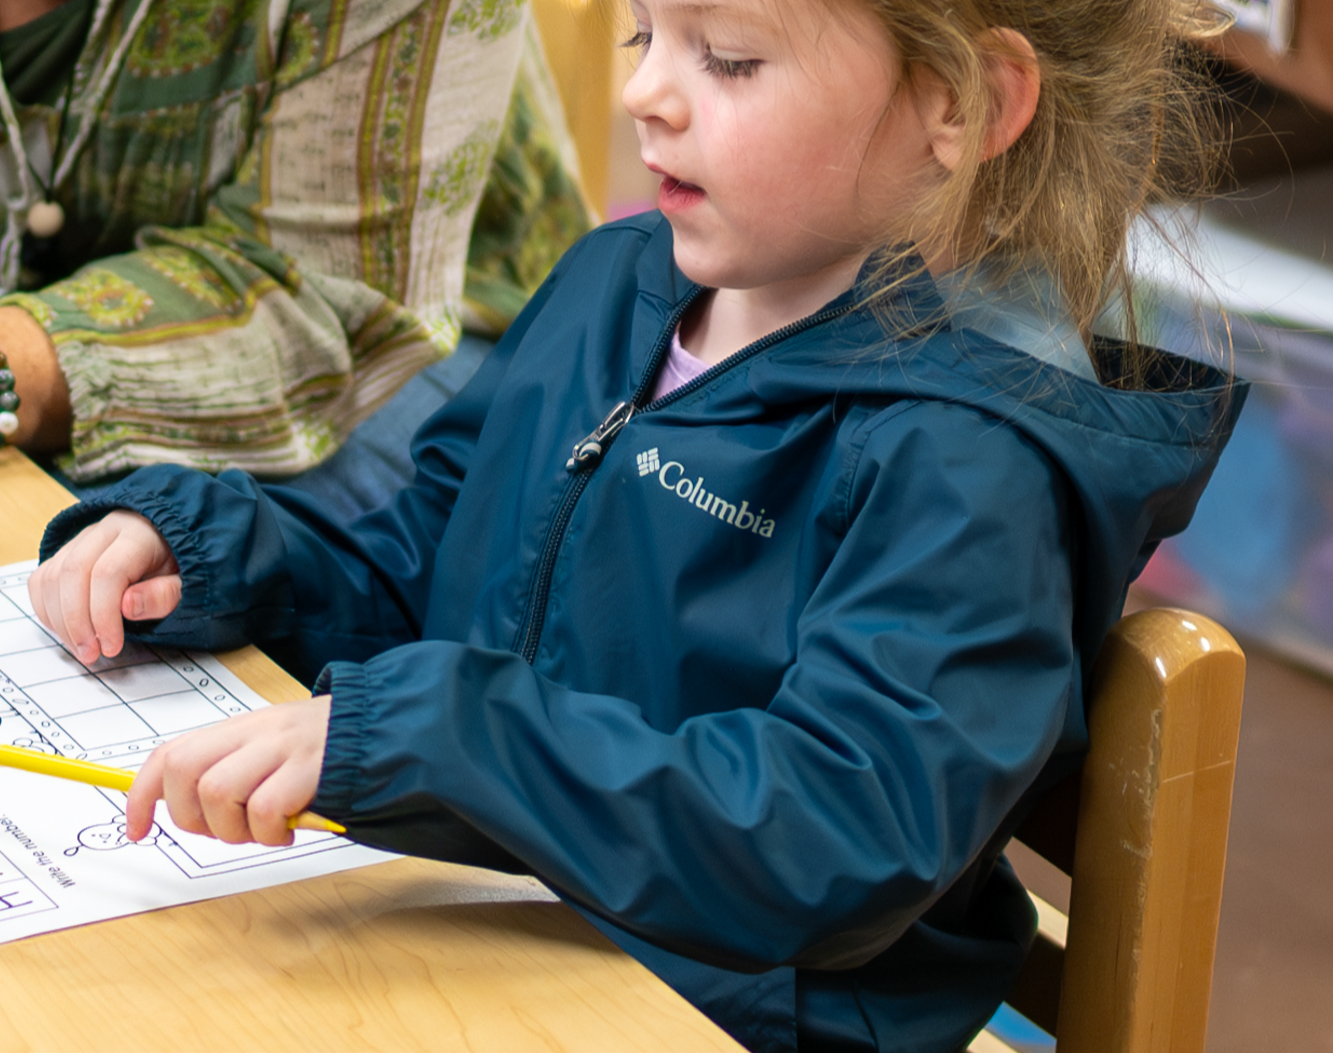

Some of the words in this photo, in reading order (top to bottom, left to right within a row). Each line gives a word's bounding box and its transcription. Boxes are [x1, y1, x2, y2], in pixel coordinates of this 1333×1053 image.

[659, 461, 776, 538] Columbia
[33, 851, 53, 866] the
[48, 866, 75, 888] Write
